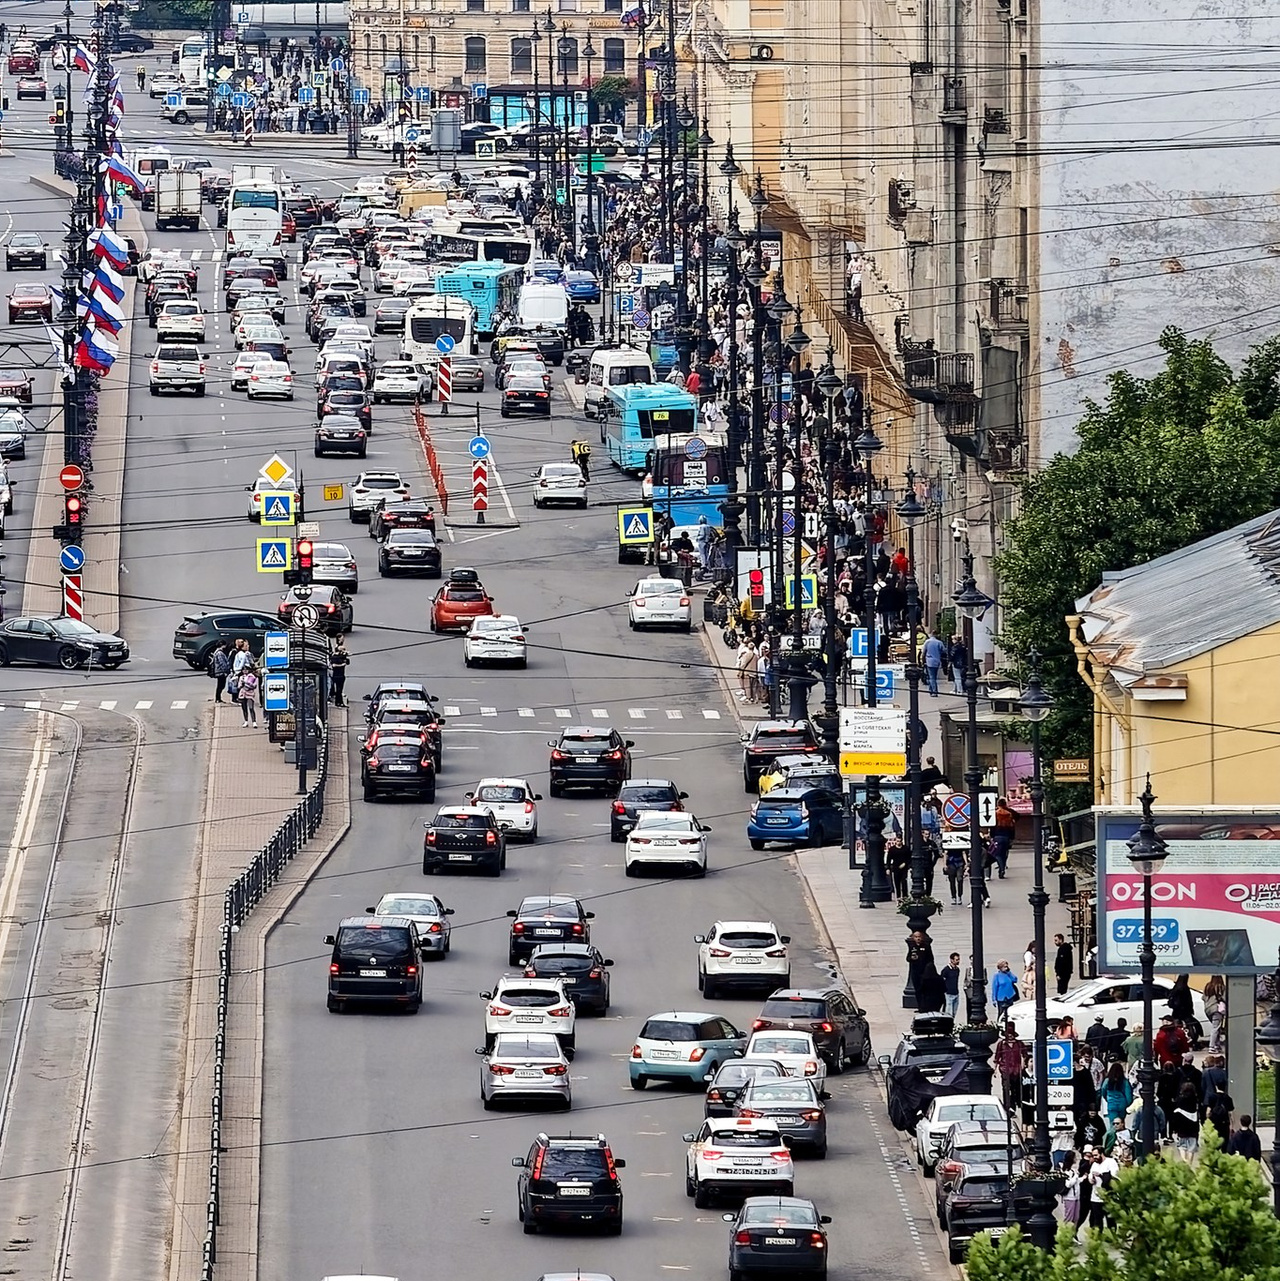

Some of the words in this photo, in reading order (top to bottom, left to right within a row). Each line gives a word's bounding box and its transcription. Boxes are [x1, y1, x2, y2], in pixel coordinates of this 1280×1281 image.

[786, 637, 815, 647] СОП
[1056, 762, 1087, 771] ОТЕЛЬ
[1111, 881, 1196, 901] OZON
[1116, 924, 1135, 938] 37
